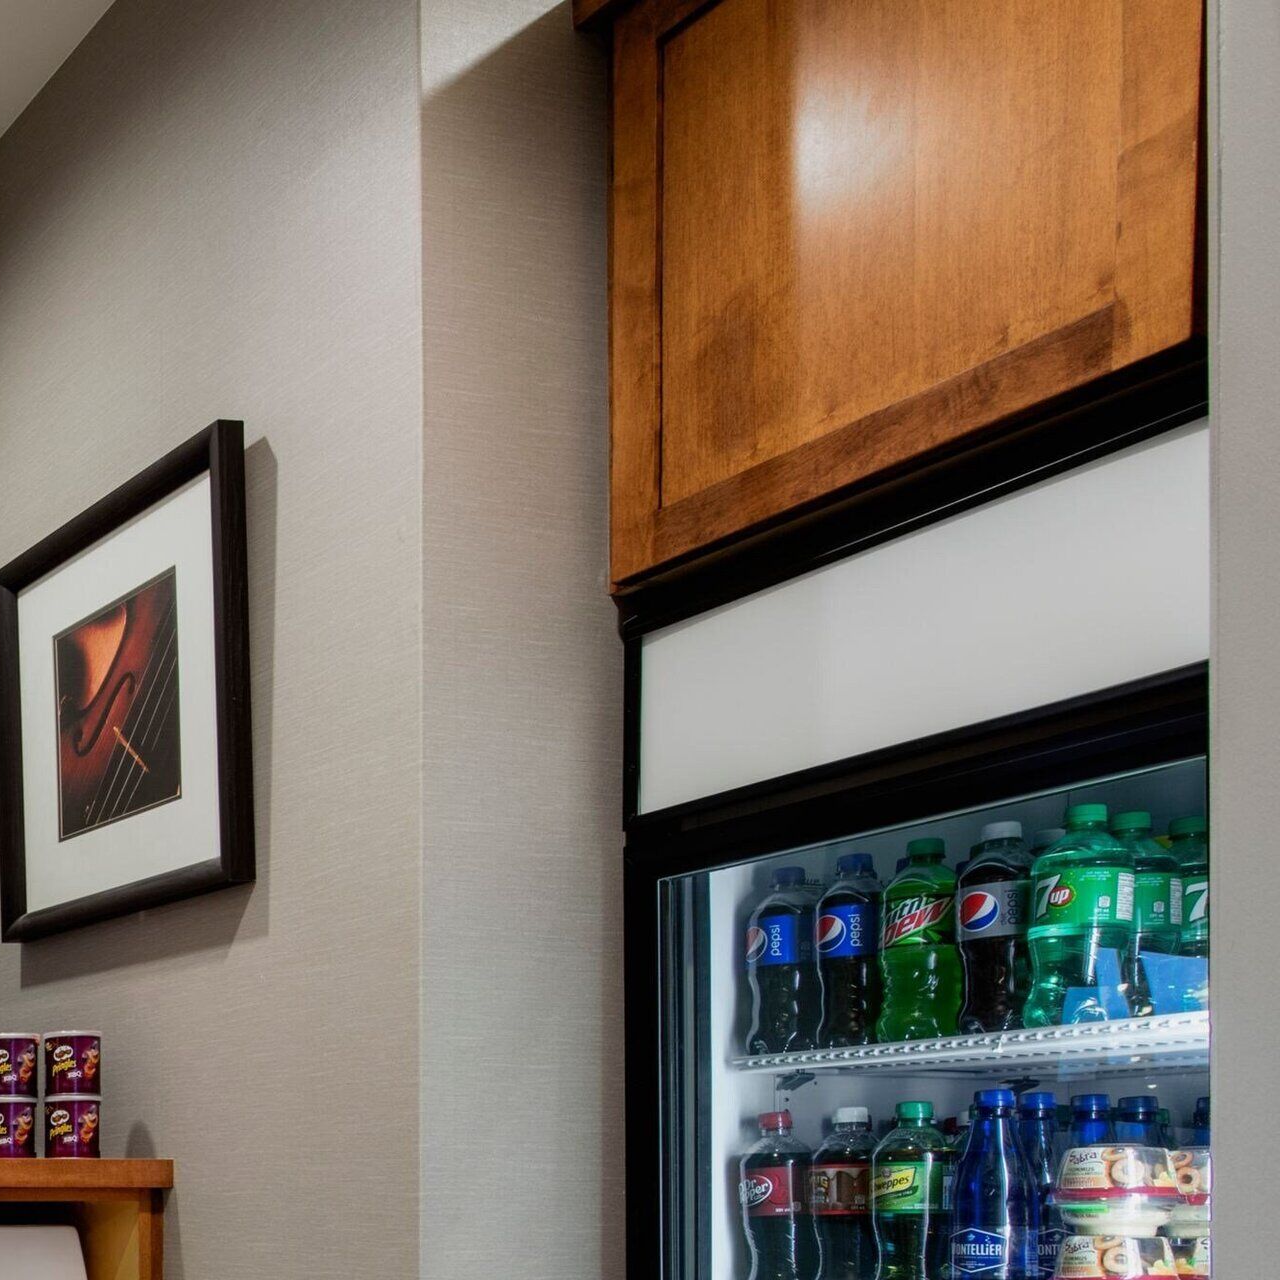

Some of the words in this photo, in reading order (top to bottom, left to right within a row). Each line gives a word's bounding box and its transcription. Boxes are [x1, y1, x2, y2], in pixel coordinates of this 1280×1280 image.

[1007, 889, 1021, 924] pepsi
[769, 924, 783, 957] pepsi
[848, 913, 863, 947] pepsi
[52, 1059, 77, 1076] Pringles
[49, 1125, 73, 1143] Pringles
[1068, 1150, 1098, 1166] Sabra
